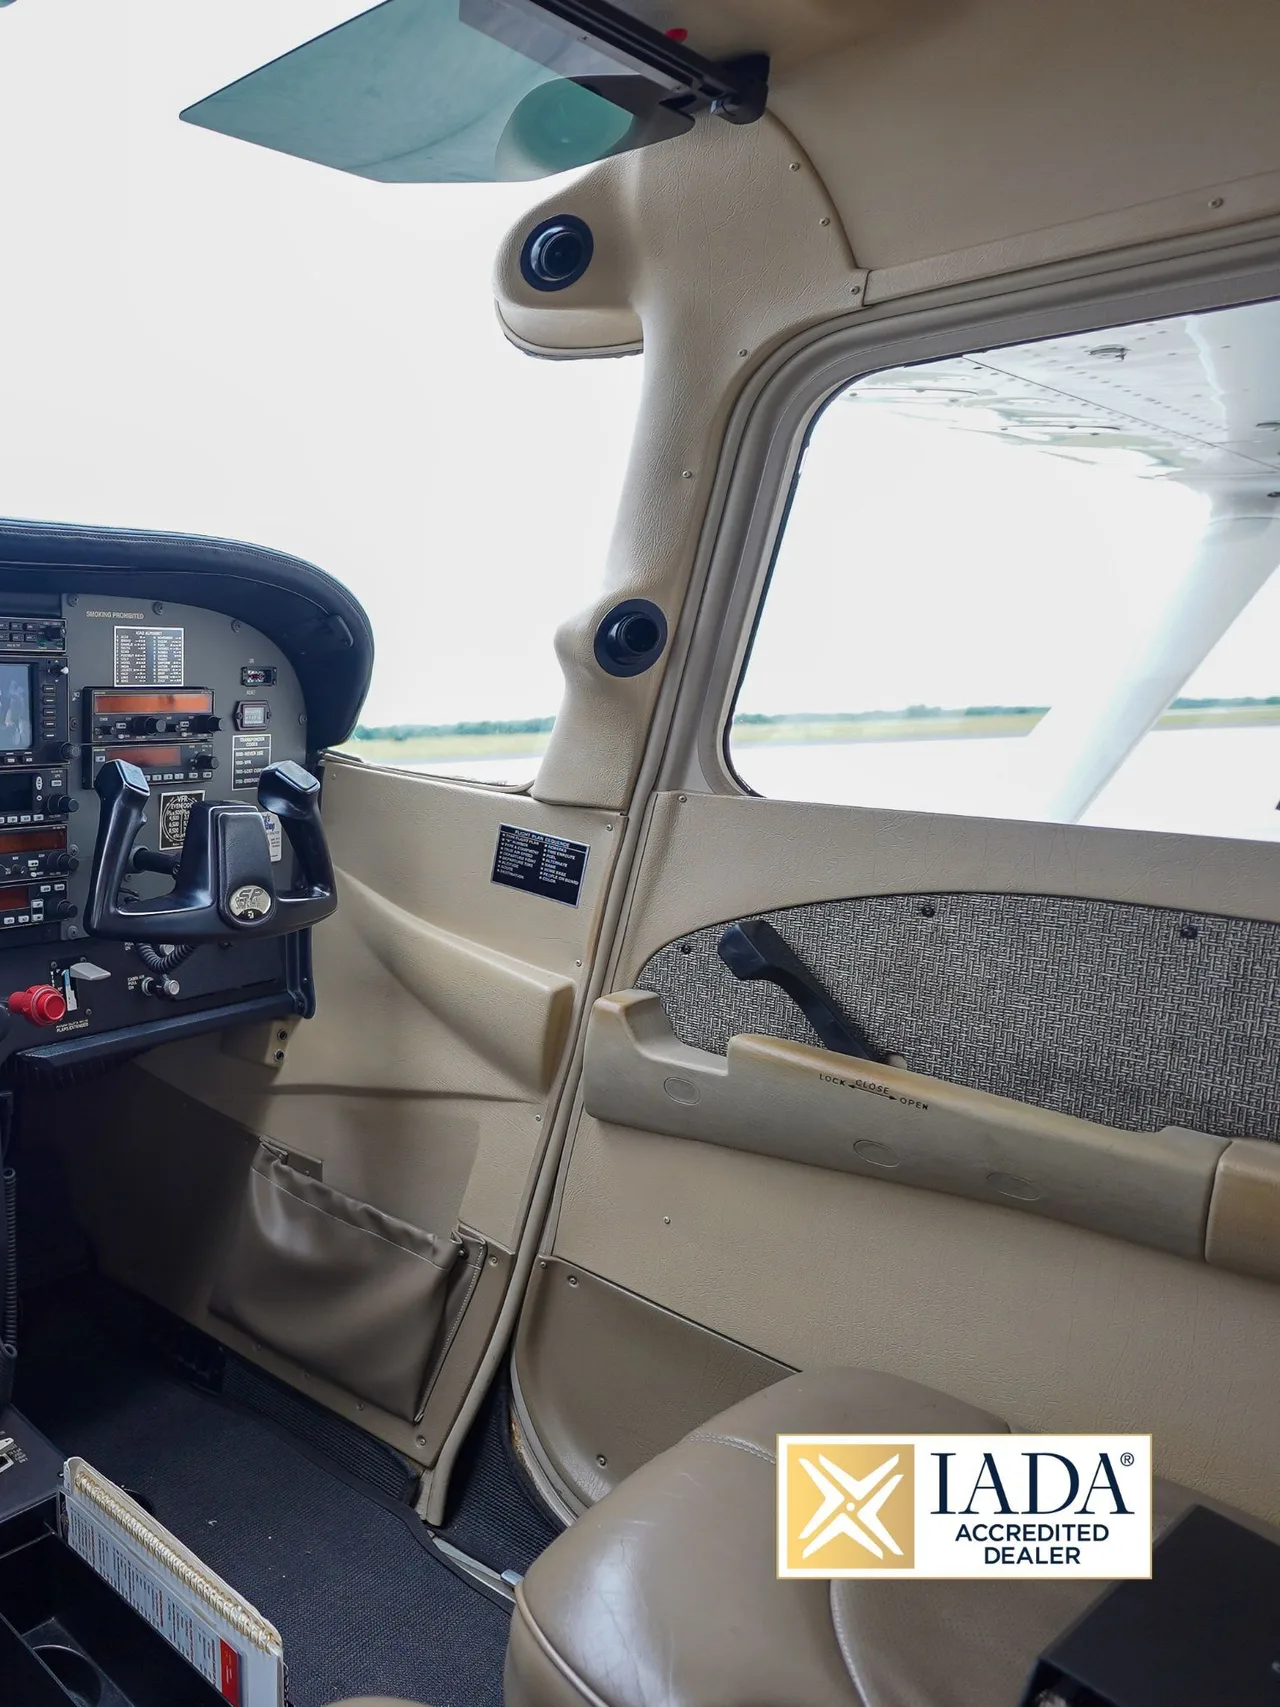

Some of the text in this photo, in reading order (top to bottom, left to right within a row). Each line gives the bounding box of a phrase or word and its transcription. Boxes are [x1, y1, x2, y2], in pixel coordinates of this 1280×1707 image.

[819, 1074, 928, 1110] LOCK CLOSE OPEN
